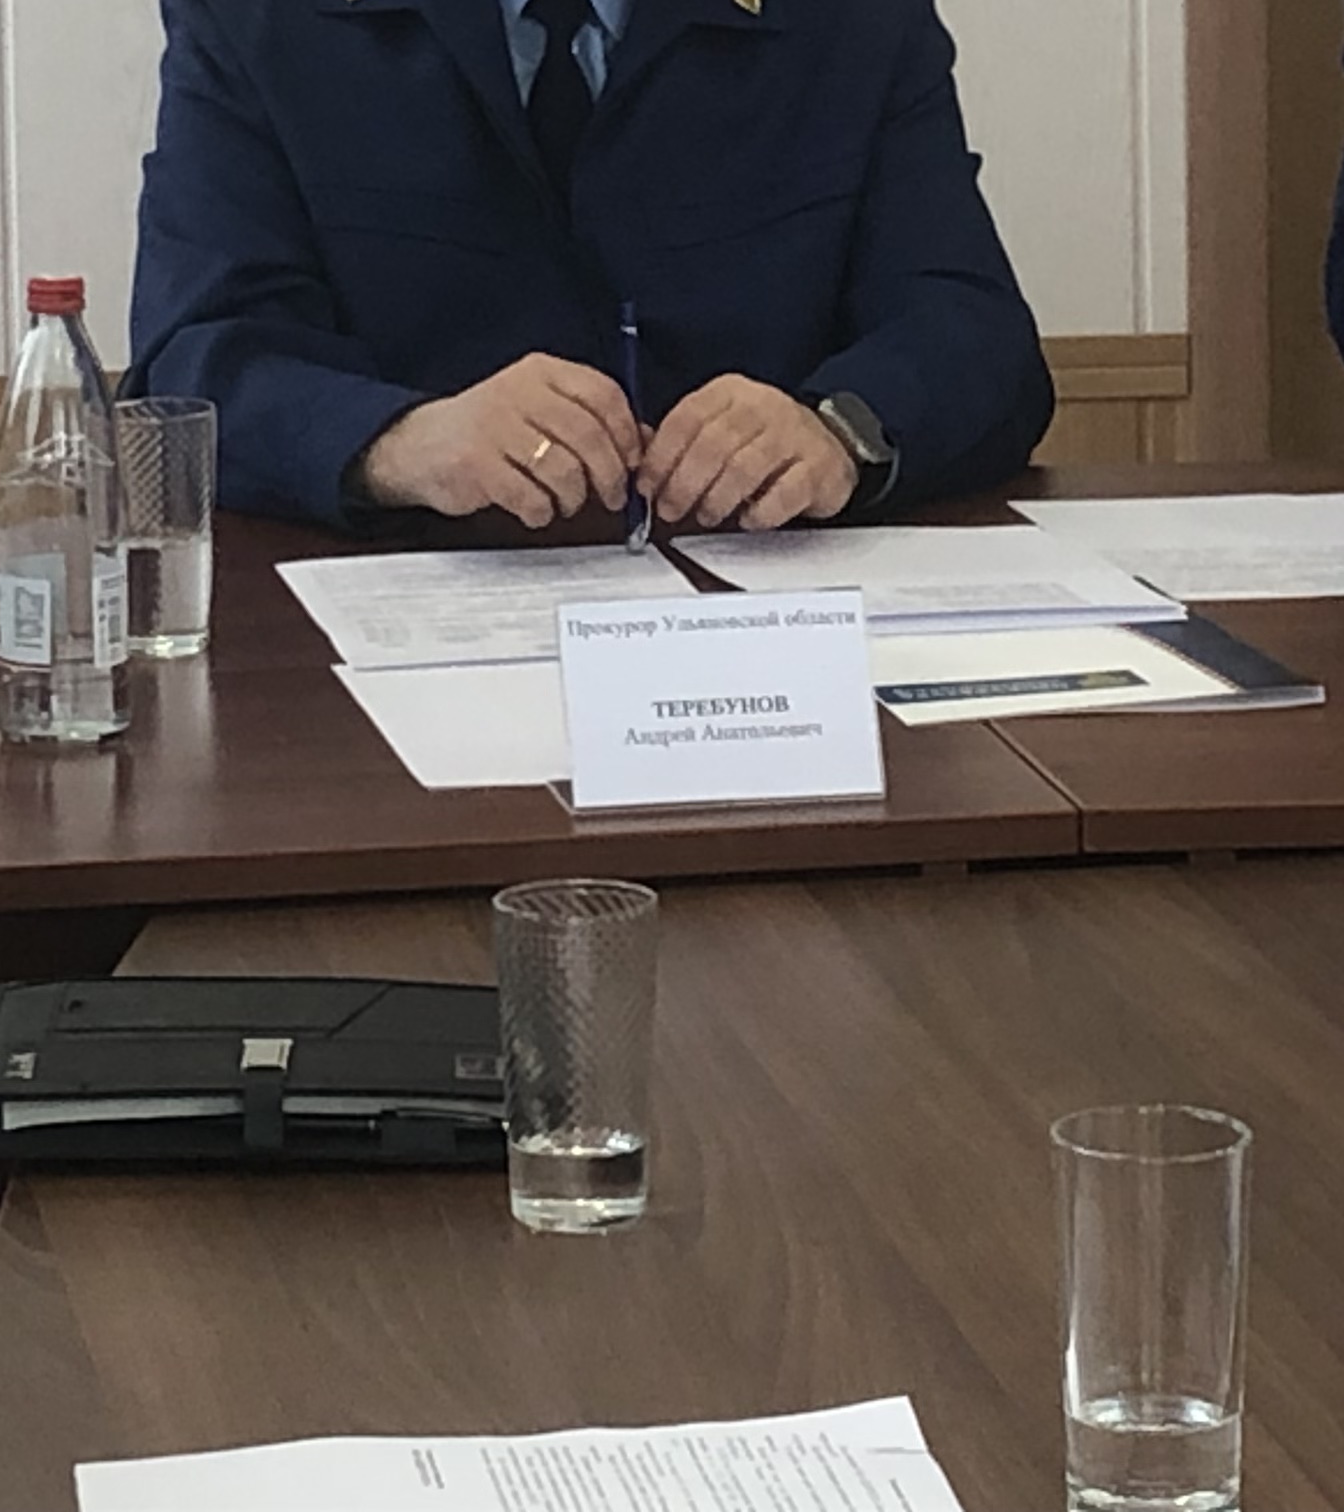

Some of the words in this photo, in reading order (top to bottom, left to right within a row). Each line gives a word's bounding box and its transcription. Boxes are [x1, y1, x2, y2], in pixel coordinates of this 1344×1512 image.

[567, 619, 658, 640] Прокурор
[662, 610, 780, 632] Ульяновской
[784, 608, 856, 627] области
[653, 695, 790, 719] ТЕРЕБУНОВ
[624, 727, 696, 748] Андрей
[702, 723, 823, 742] Анатольевич
